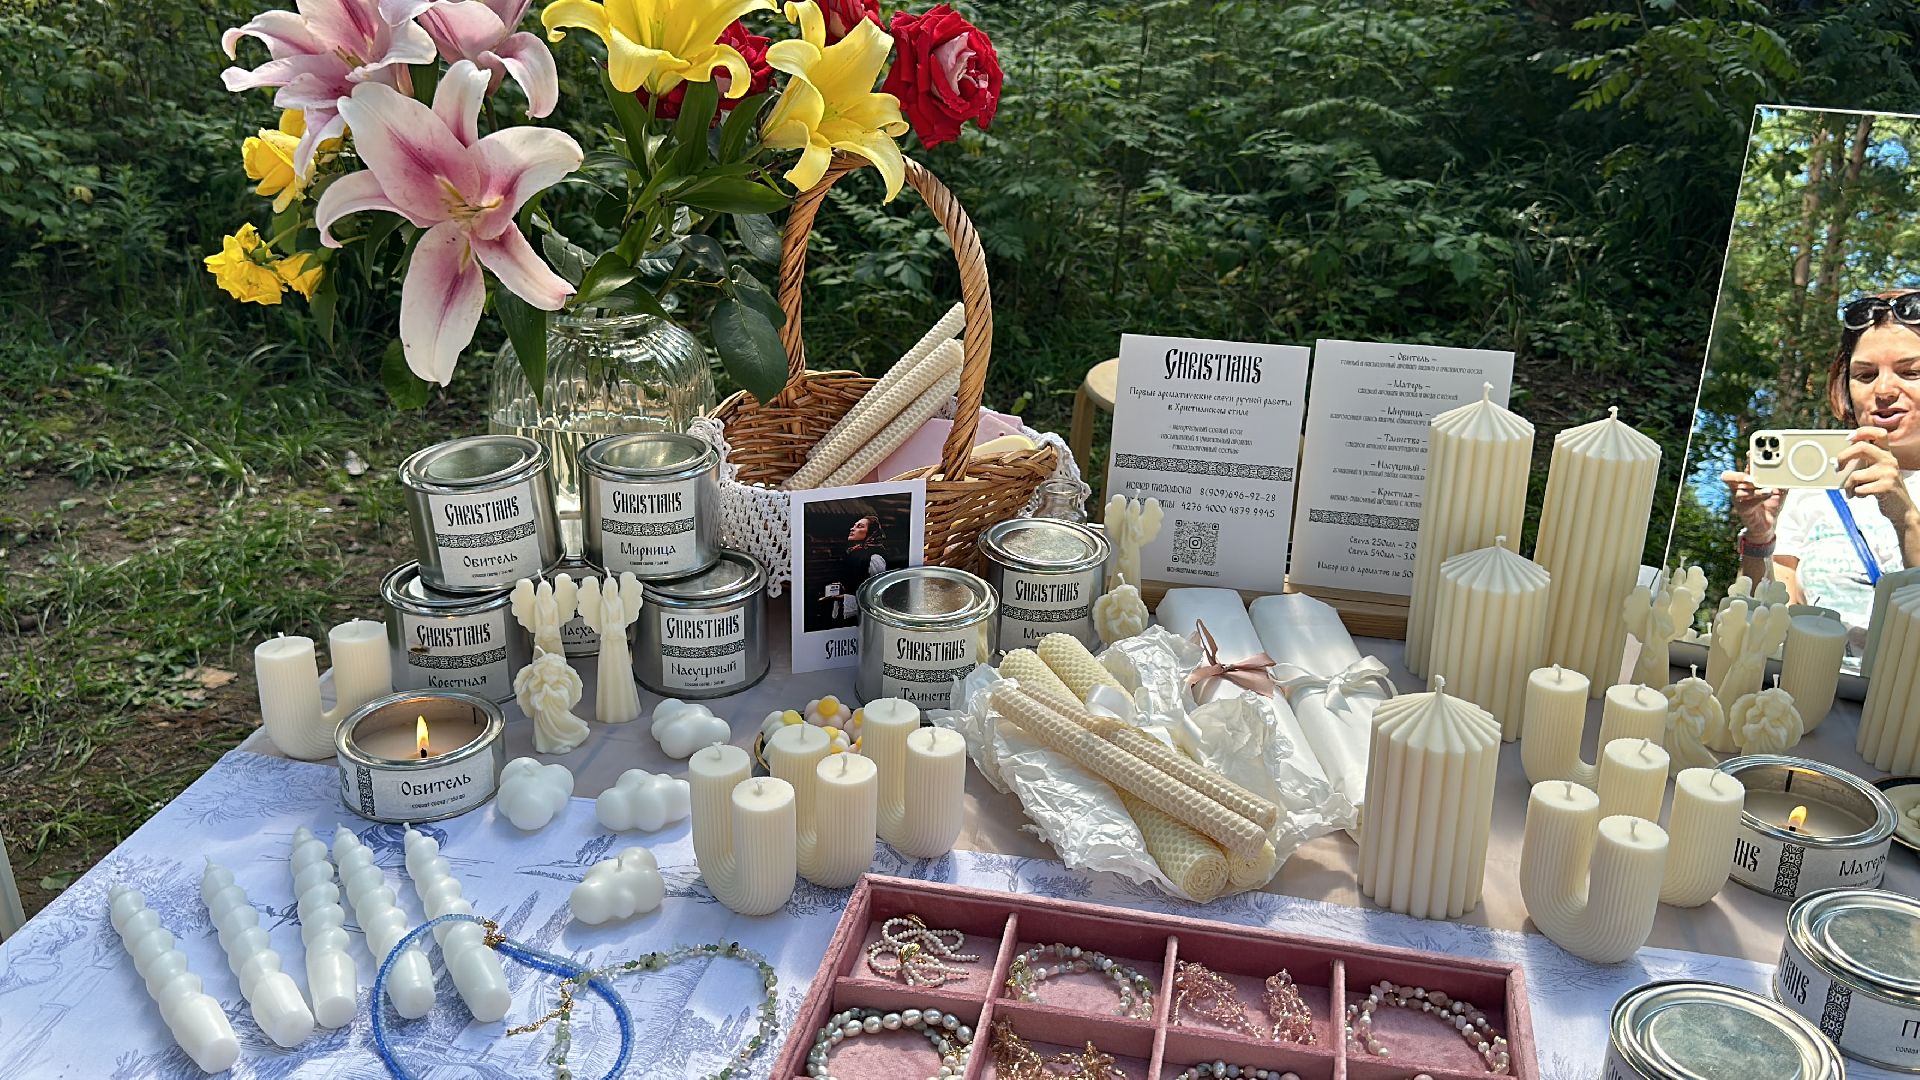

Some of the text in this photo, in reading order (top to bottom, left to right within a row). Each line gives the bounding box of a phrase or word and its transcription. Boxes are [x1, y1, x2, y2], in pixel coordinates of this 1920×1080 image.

[1129, 386, 1156, 399] Первые
[463, 552, 518, 568] Обитель
[620, 541, 676, 561] Мирница
[825, 638, 858, 660] CHRIS
[671, 660, 737, 681] Насущный
[428, 674, 487, 689] Крестная
[901, 687, 951, 702] Таинств
[401, 773, 471, 796] Обитель
